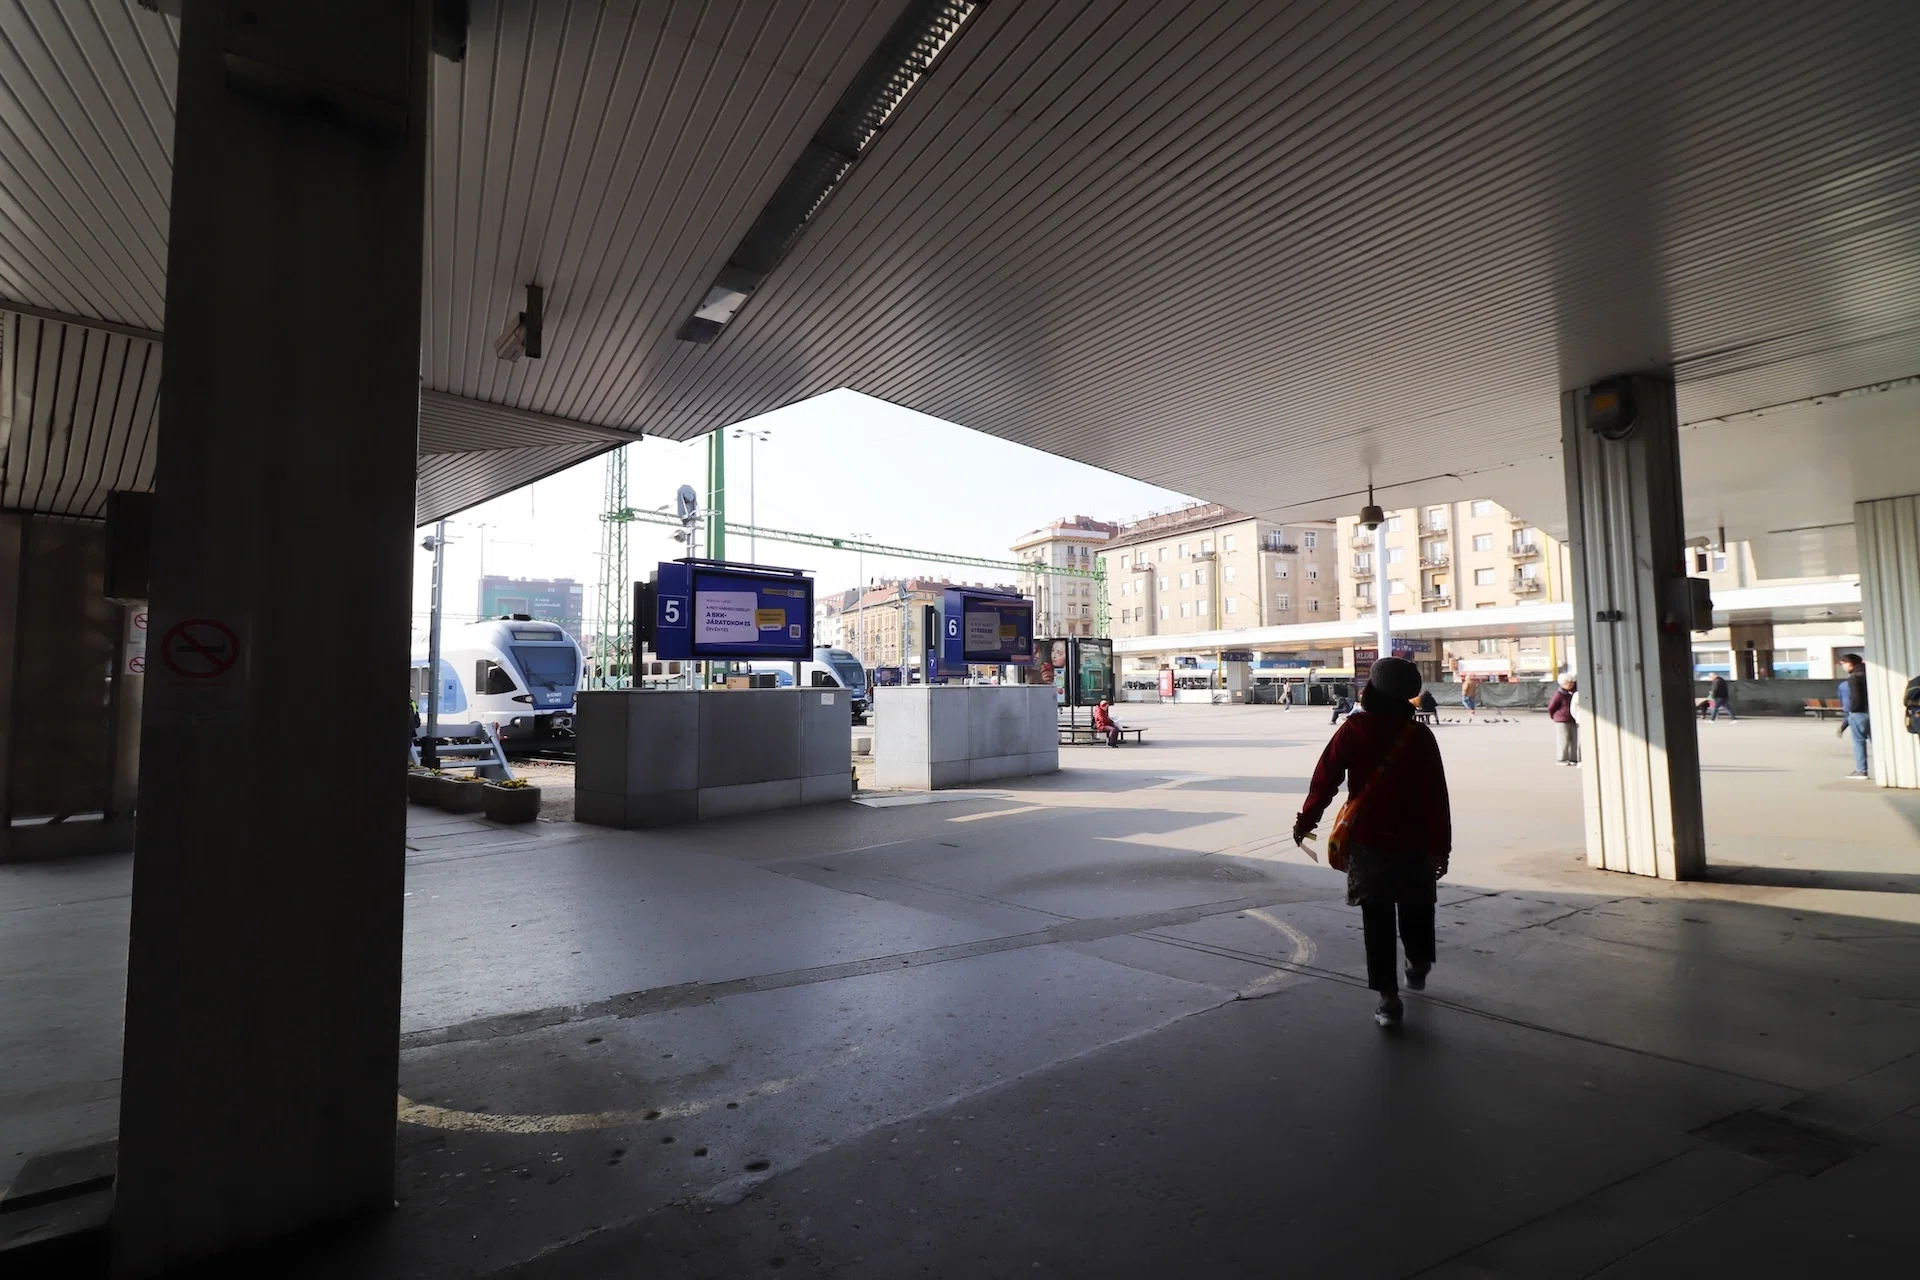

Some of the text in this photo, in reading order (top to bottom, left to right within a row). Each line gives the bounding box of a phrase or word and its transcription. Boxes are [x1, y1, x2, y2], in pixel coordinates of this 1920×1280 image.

[665, 600, 680, 623] 5
[948, 619, 957, 636] 6
[930, 659, 934, 667] 7
